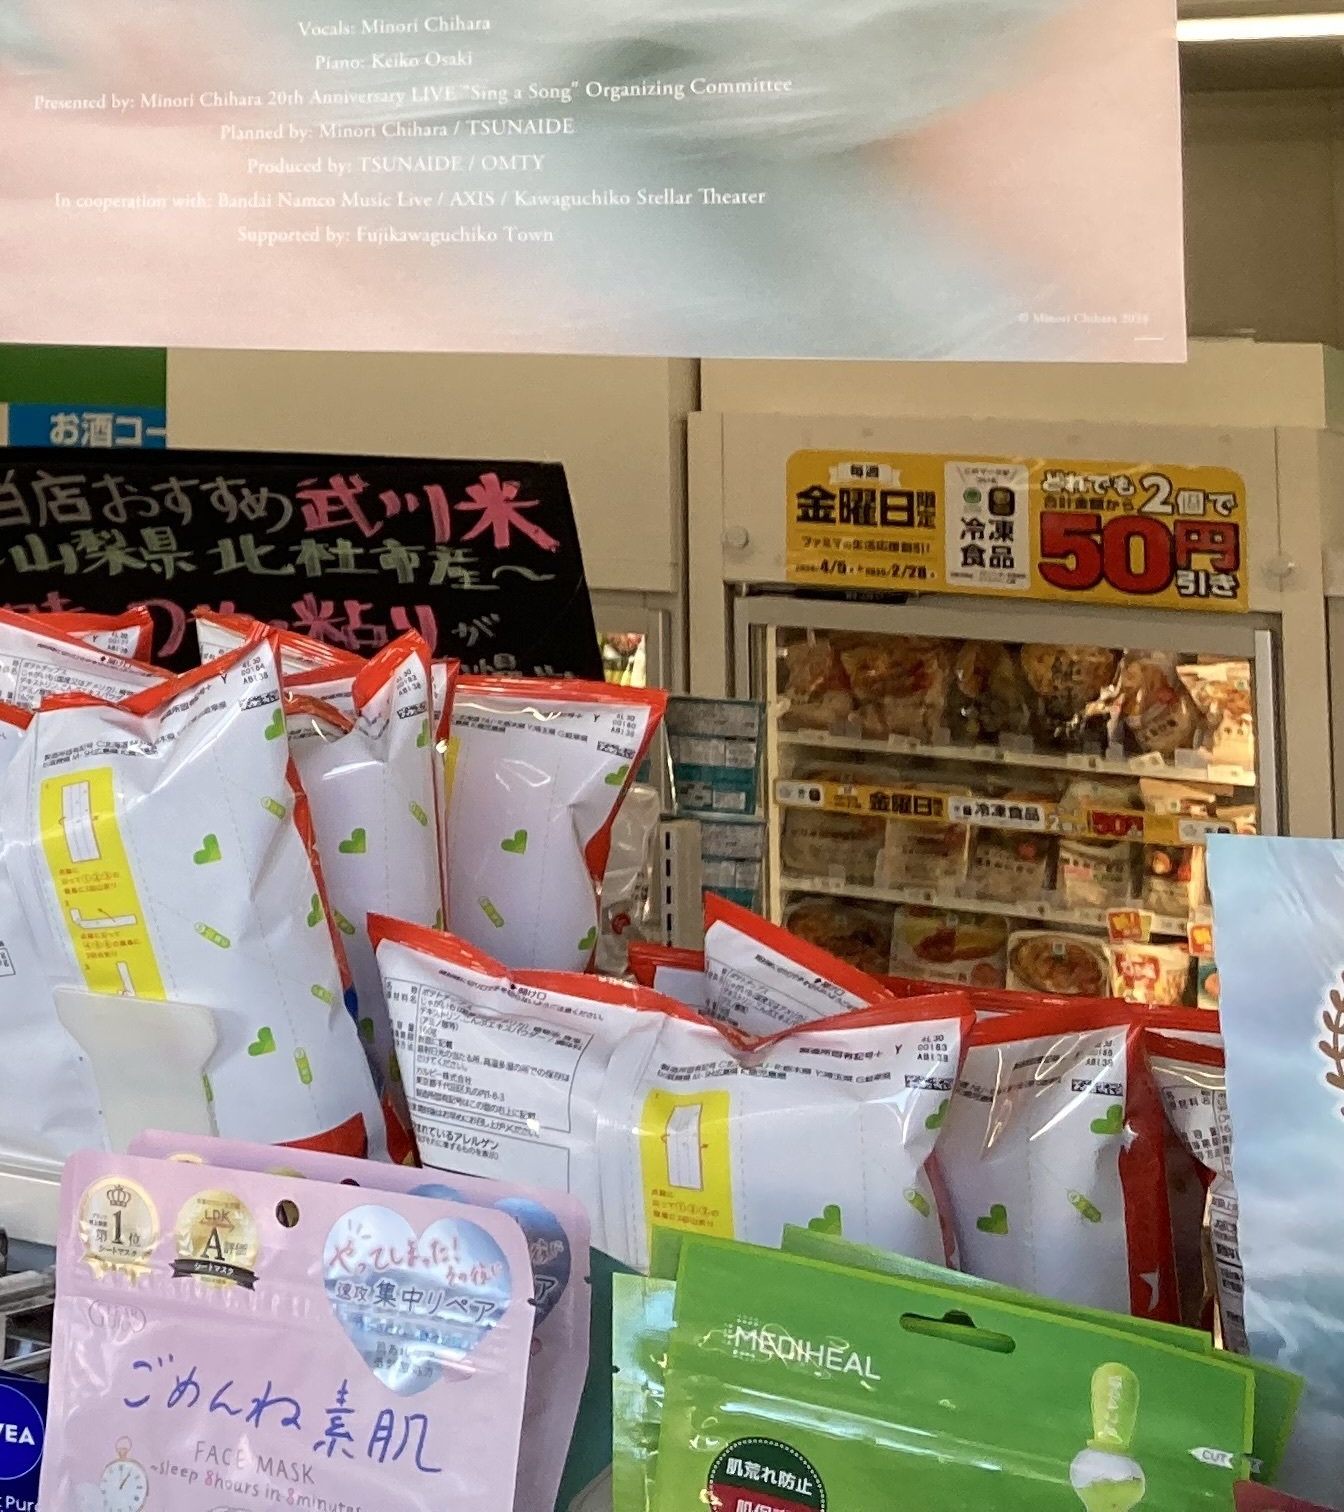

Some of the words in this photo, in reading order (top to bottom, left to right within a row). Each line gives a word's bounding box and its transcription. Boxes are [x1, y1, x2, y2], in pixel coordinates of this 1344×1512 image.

[298, 21, 355, 37] Vocals:
[361, 19, 418, 34] Minori
[424, 15, 491, 33] Chihara
[315, 55, 365, 70] Piano:
[372, 53, 419, 69] Keiko
[425, 51, 473, 67] Osaki
[34, 94, 106, 110] Presented
[111, 93, 135, 113] by:
[140, 92, 194, 108] Minori
[199, 90, 262, 108] Chihara
[267, 89, 303, 106] 20th
[309, 89, 405, 107] Anniversary
[412, 86, 457, 103] LIVE
[514, 90, 522, 100] a
[585, 80, 685, 102] Organizing
[690, 78, 793, 95] Committee
[220, 124, 283, 140] Planned
[289, 123, 313, 143] by:
[319, 121, 376, 138] Minori
[382, 120, 448, 137] Chihara
[465, 118, 575, 136] TSUNAIDE
[247, 158, 322, 174] Produced
[327, 157, 353, 176] by:
[360, 155, 463, 173] TSUNAIDE
[481, 154, 546, 172] OMTY
[55, 192, 71, 208] In
[76, 194, 165, 213] cooperation
[172, 192, 207, 208] with:
[218, 192, 271, 208] Bandai
[278, 192, 335, 208] Namco
[341, 191, 392, 207] Music
[398, 191, 433, 207] Live
[449, 191, 495, 207] AXIS
[514, 189, 631, 211] Kawaguchiko
[636, 188, 693, 206] Stellar
[698, 188, 766, 205] Theater
[238, 226, 320, 246] Supported
[325, 226, 351, 245] by:
[356, 225, 497, 247] Fujikawaguchiko
[503, 225, 554, 242] Town
[204, 1209, 231, 1221] LDK
[735, 1325, 881, 1381] MEDIHEAL
[194, 1440, 247, 1467] FACE
[256, 1456, 315, 1485] MASK
[726, 1457, 813, 1496] 肌荒れ防止
